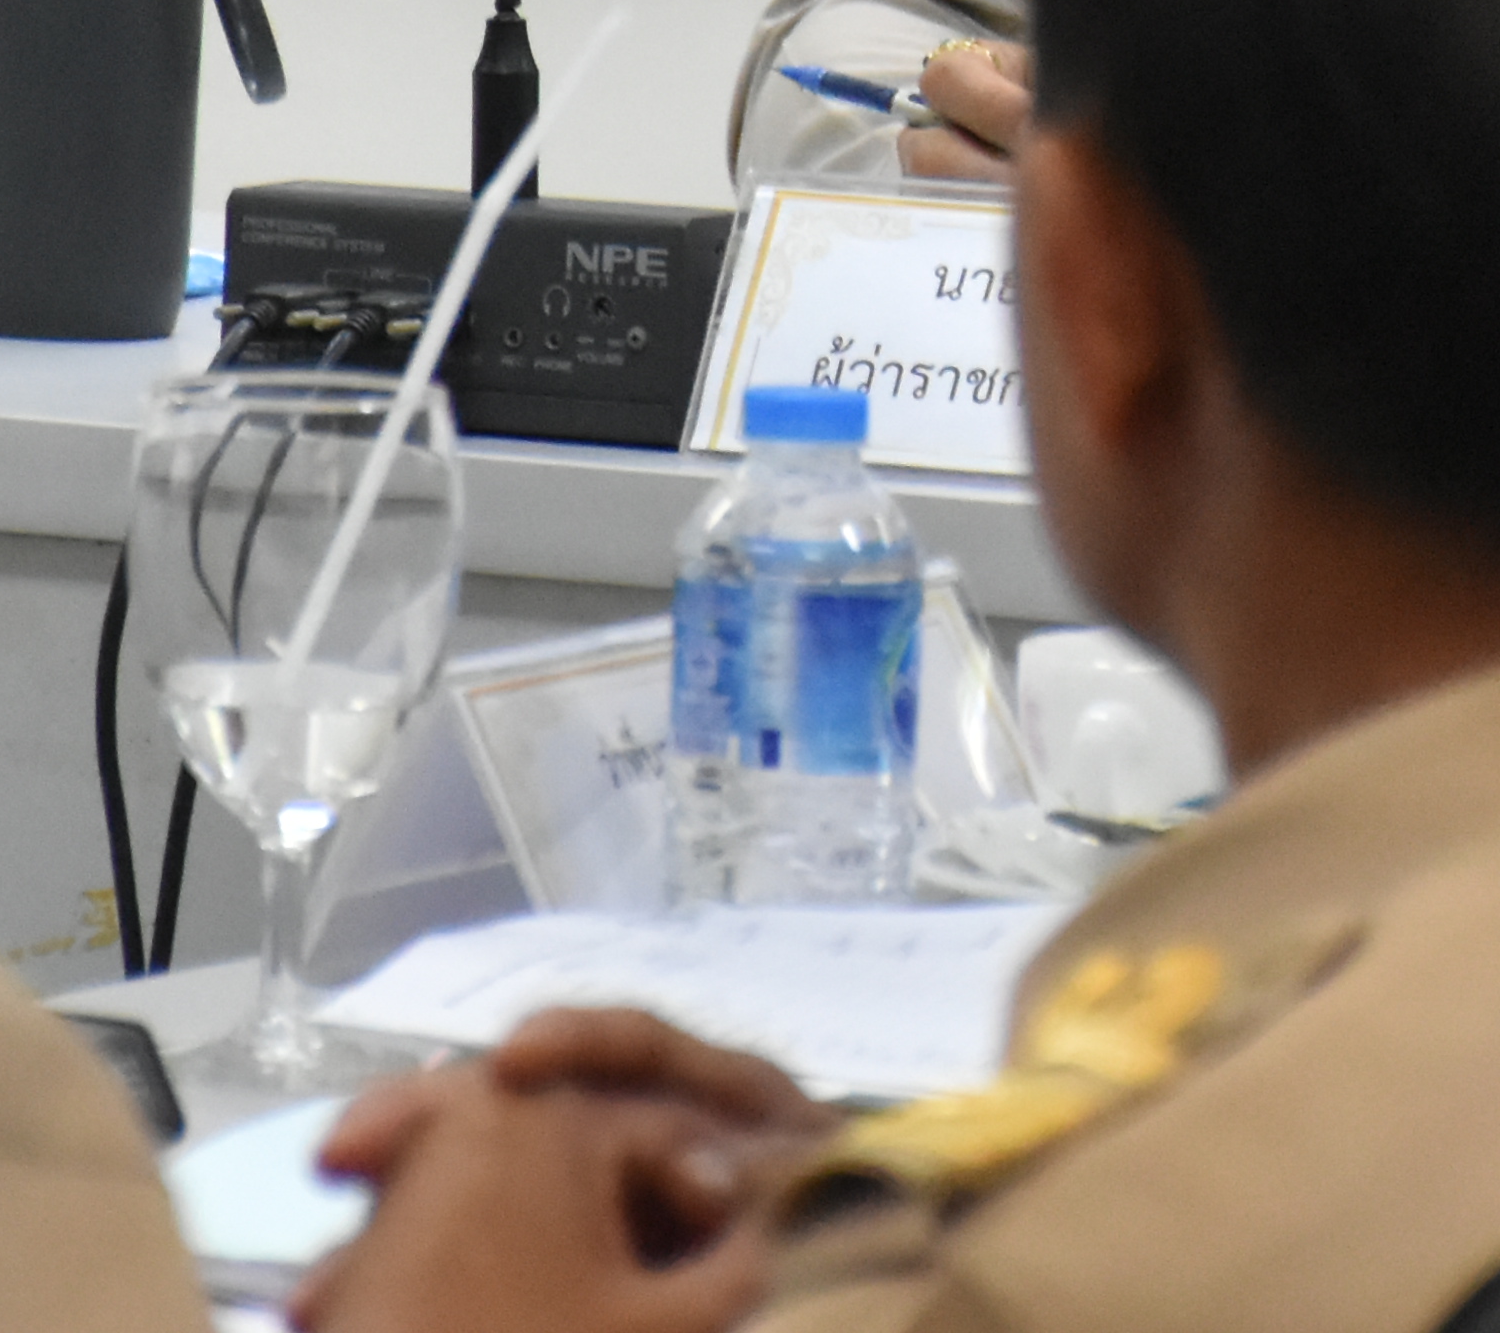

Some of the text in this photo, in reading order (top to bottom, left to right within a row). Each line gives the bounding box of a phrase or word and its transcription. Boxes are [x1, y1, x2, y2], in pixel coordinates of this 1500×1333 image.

[241, 231, 386, 253] CONFERENCE SYSTEM
[565, 240, 669, 279] NPE
[810, 334, 1023, 407] ผ้ว่าราชก
